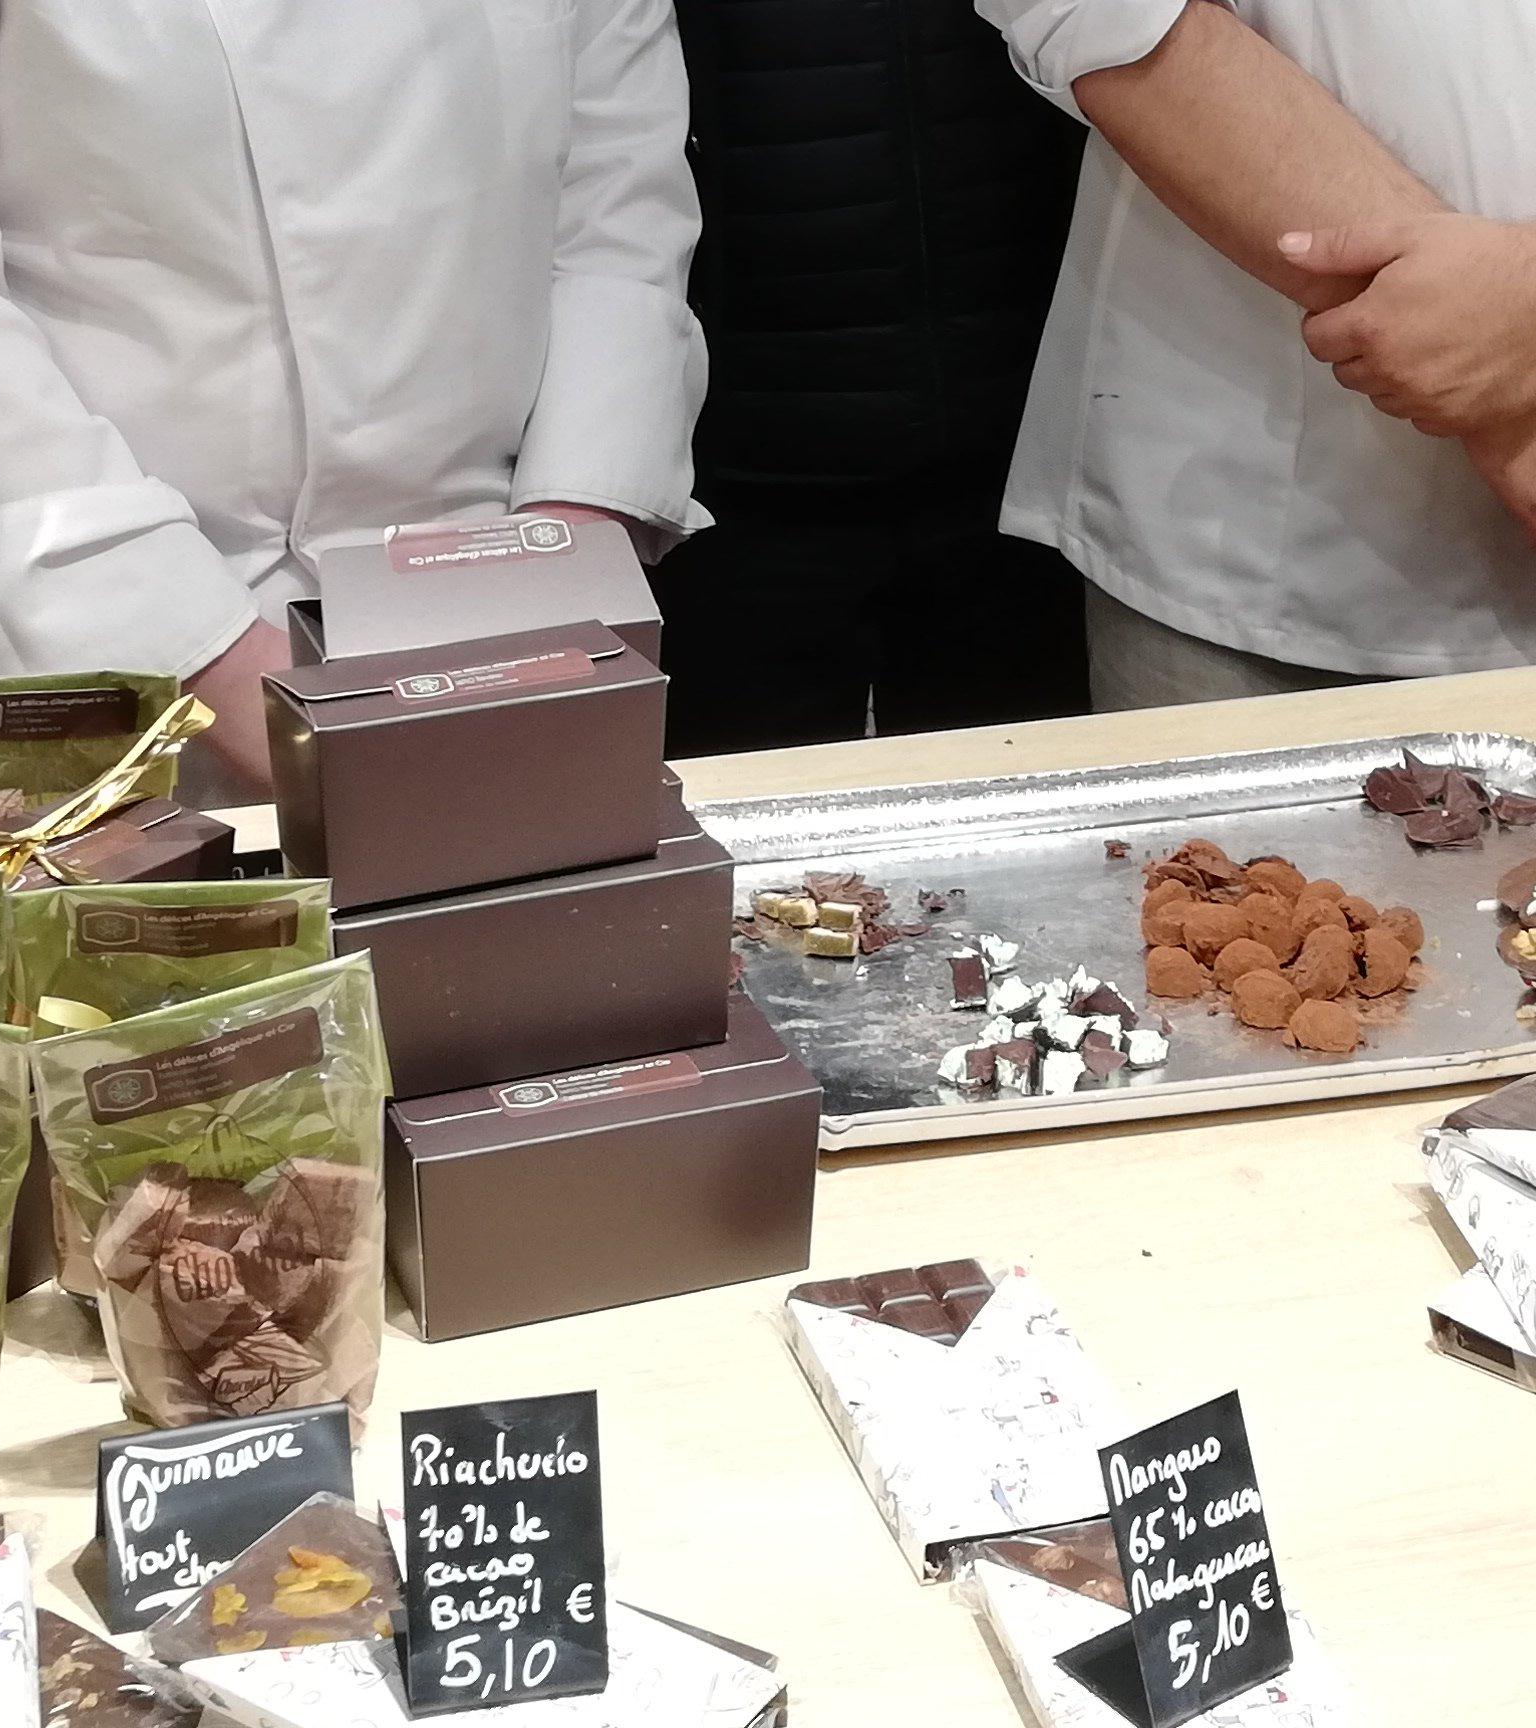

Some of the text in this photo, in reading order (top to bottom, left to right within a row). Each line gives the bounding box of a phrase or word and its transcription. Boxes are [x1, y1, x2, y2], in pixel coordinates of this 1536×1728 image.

[410, 1432, 589, 1487] Riachuelo
[509, 1500, 550, 1543] de
[423, 1552, 536, 1587] cacao
[565, 1583, 596, 1624] €
[440, 1633, 558, 1700] 5,10
